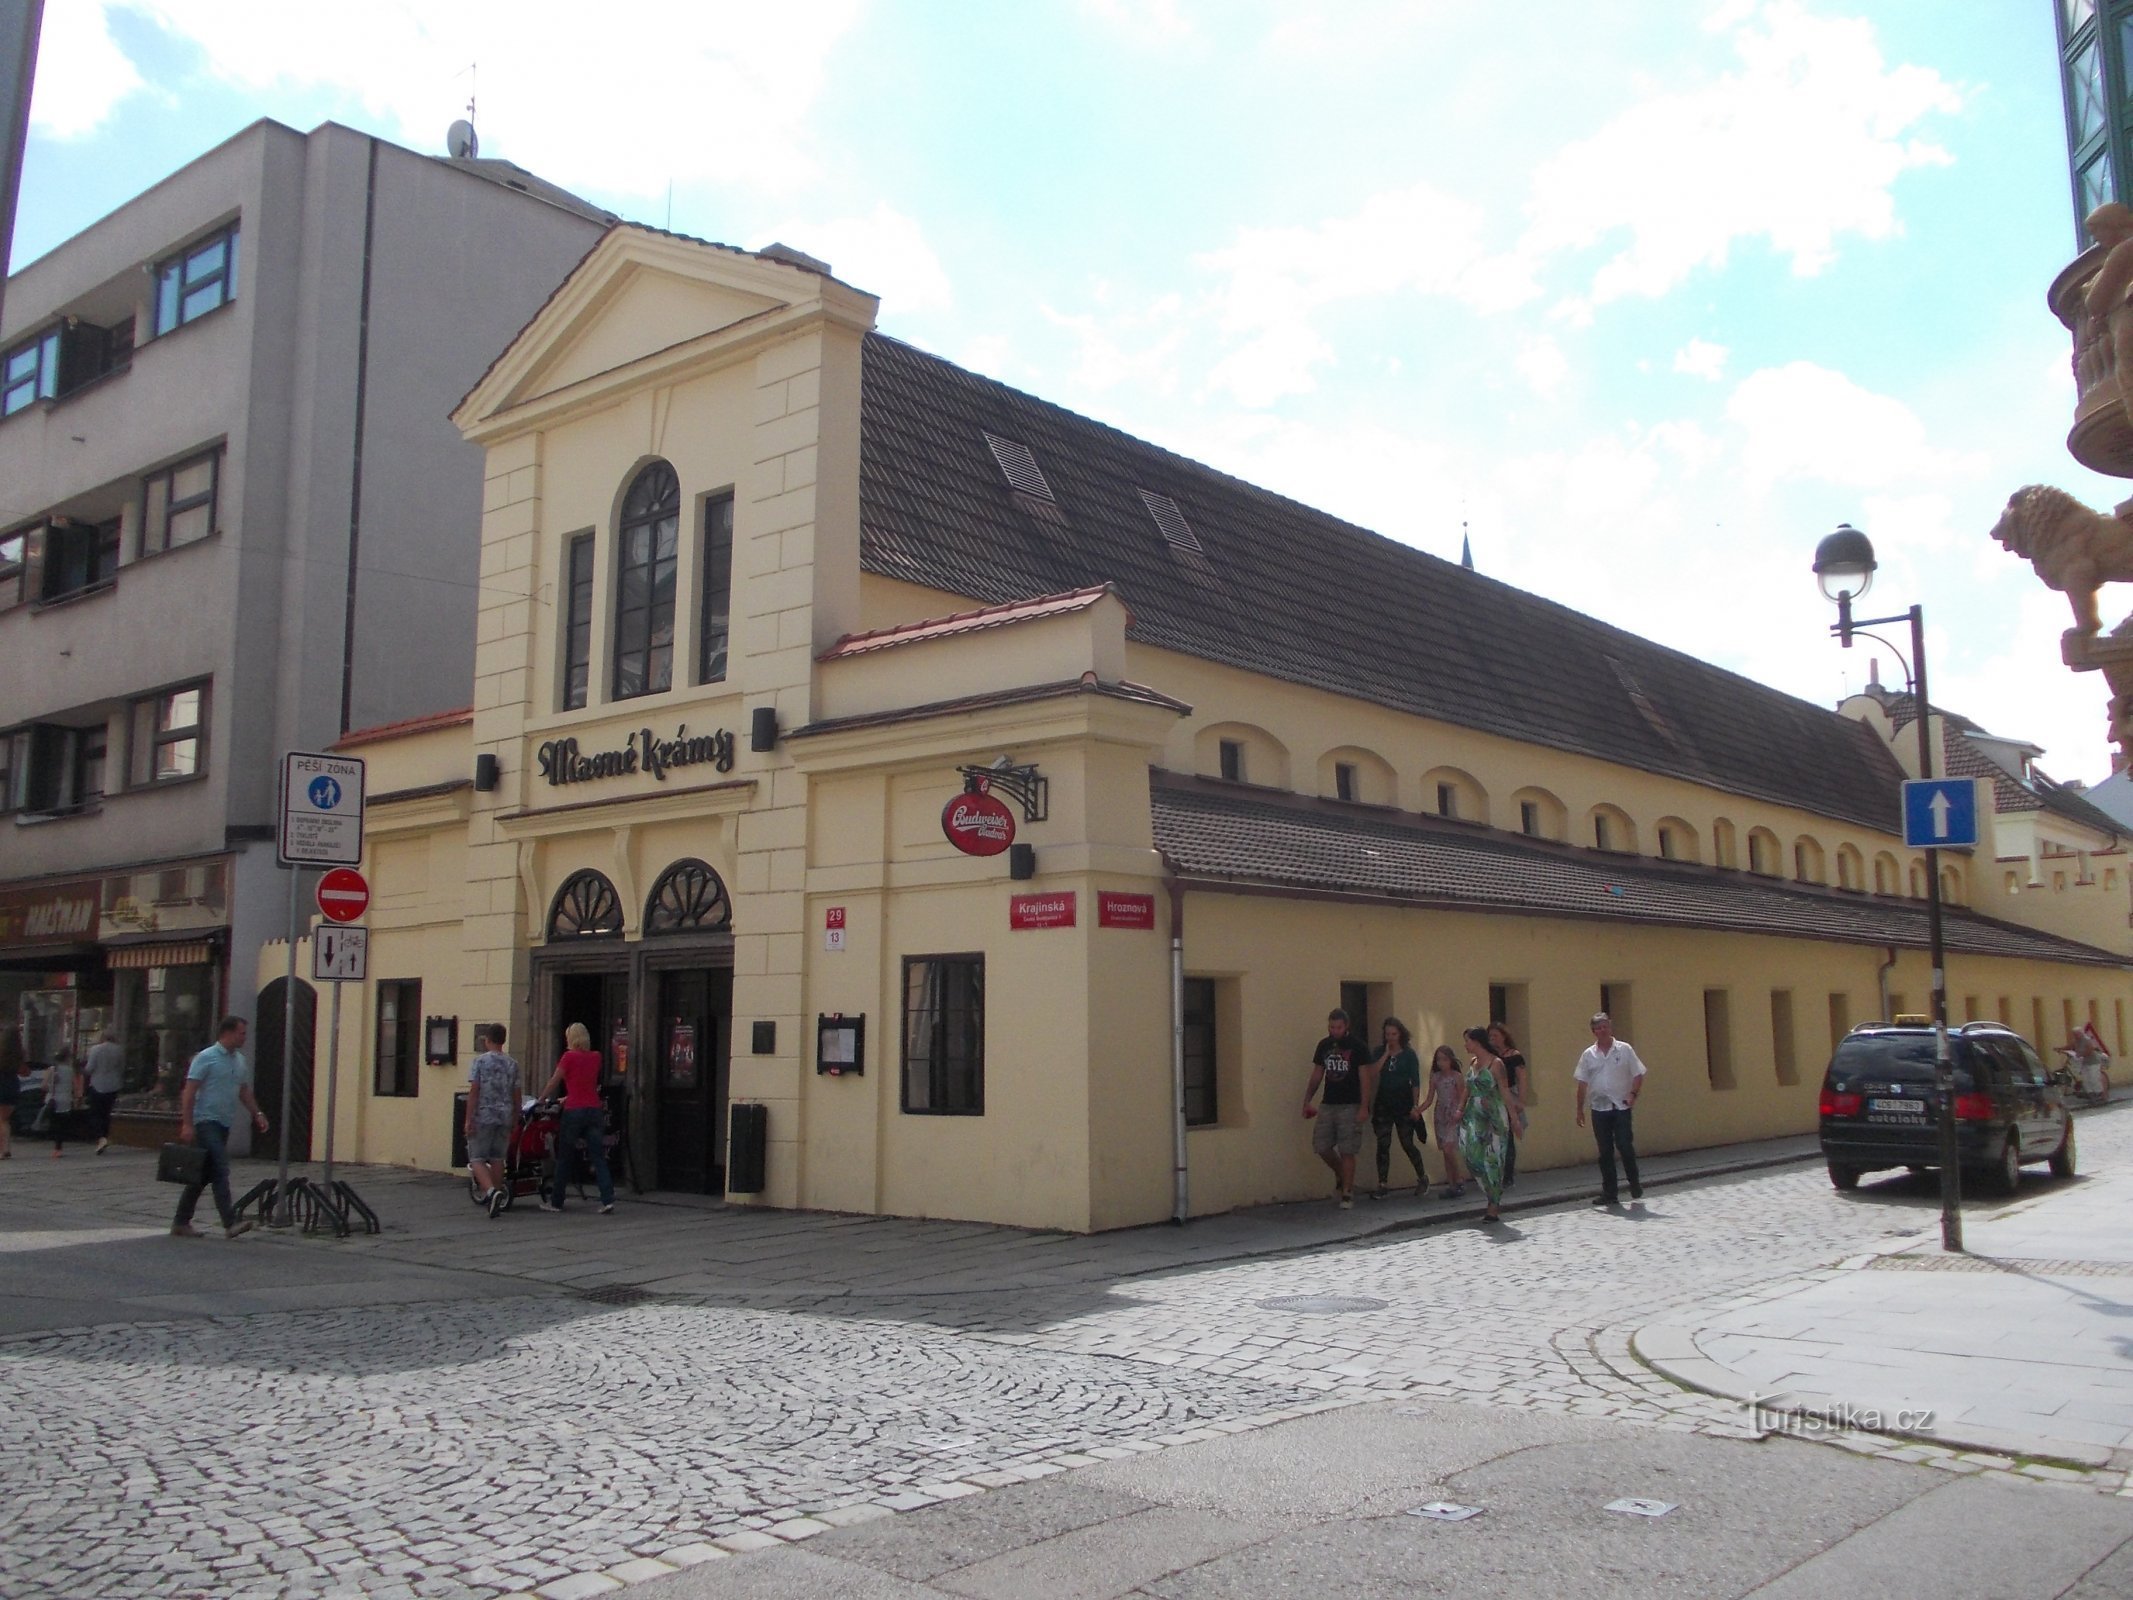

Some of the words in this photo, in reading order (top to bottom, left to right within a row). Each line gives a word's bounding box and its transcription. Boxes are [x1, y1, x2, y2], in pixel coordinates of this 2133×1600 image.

[538, 732, 638, 786] Masné
[640, 723, 735, 781] Krámy
[297, 760, 322, 772] PĚŠÍ
[327, 762, 356, 775] ZÓNA
[952, 805, 1008, 828] Budweiser
[1019, 901, 1065, 915] Krajinská
[1107, 901, 1147, 913] Hroznová
[829, 909, 842, 921] 29
[831, 932, 840, 943] 13
